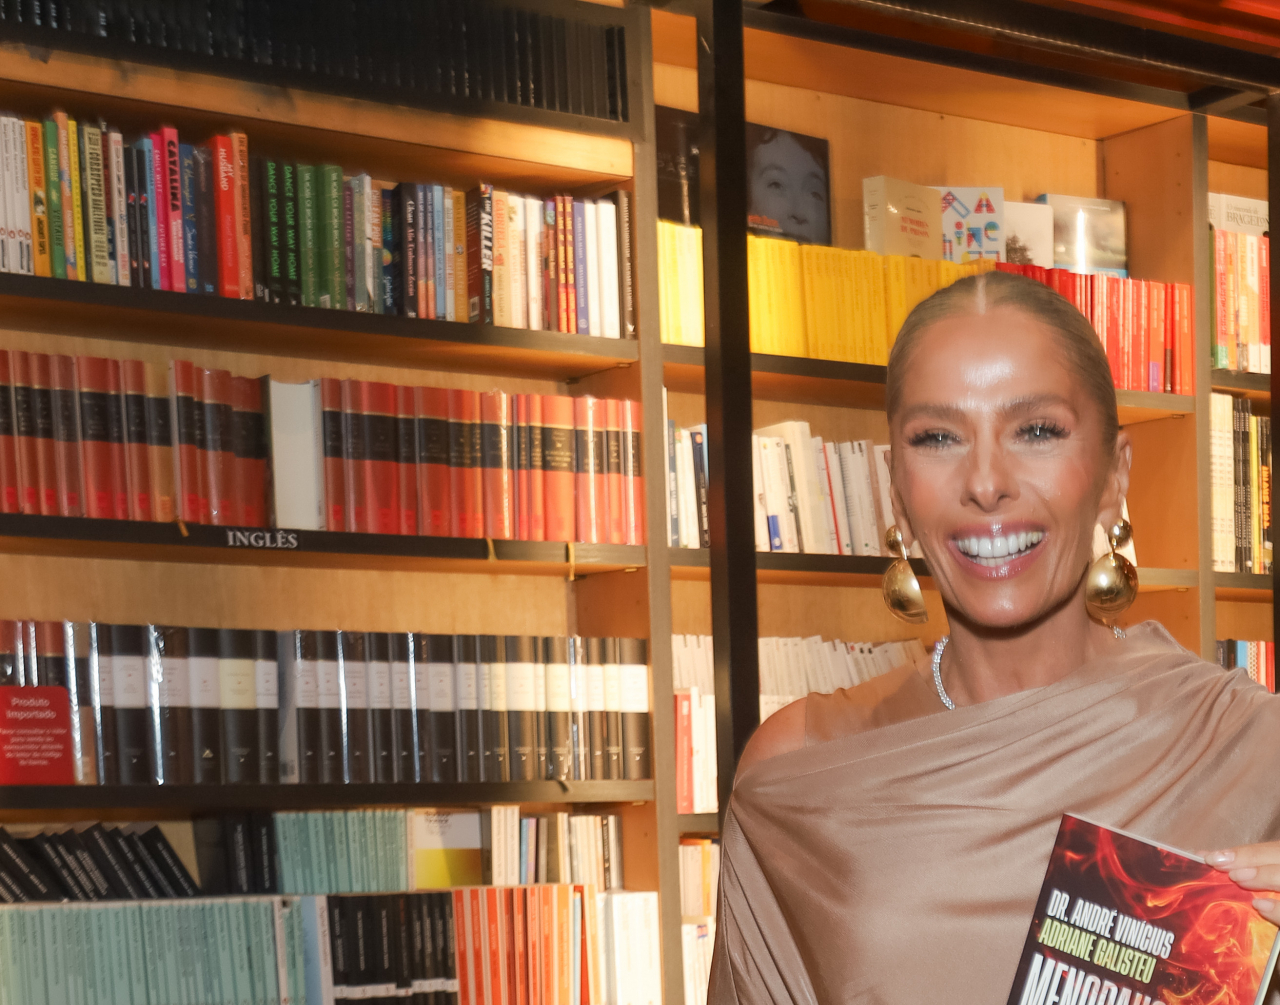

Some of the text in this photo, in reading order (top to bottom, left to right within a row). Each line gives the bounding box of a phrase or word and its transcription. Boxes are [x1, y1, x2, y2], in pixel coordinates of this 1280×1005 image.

[49, 148, 58, 182] CANDIDE
[90, 152, 102, 197] CORRUPTED
[168, 140, 180, 212] CATALINA
[267, 162, 276, 193] DANCE
[270, 198, 278, 222] YOUR
[53, 210, 62, 247] VOLTAIRE
[481, 213, 493, 271] KILLER
[272, 250, 280, 277] HOME
[226, 530, 298, 548] INGLÊS
[6, 710, 56, 720] Importado
[10, 698, 50, 708] Produto
[1046, 889, 1175, 960] DR. ANDRÉ VINÍCIUS
[1038, 918, 1157, 984] ADRIANE GALISTEU
